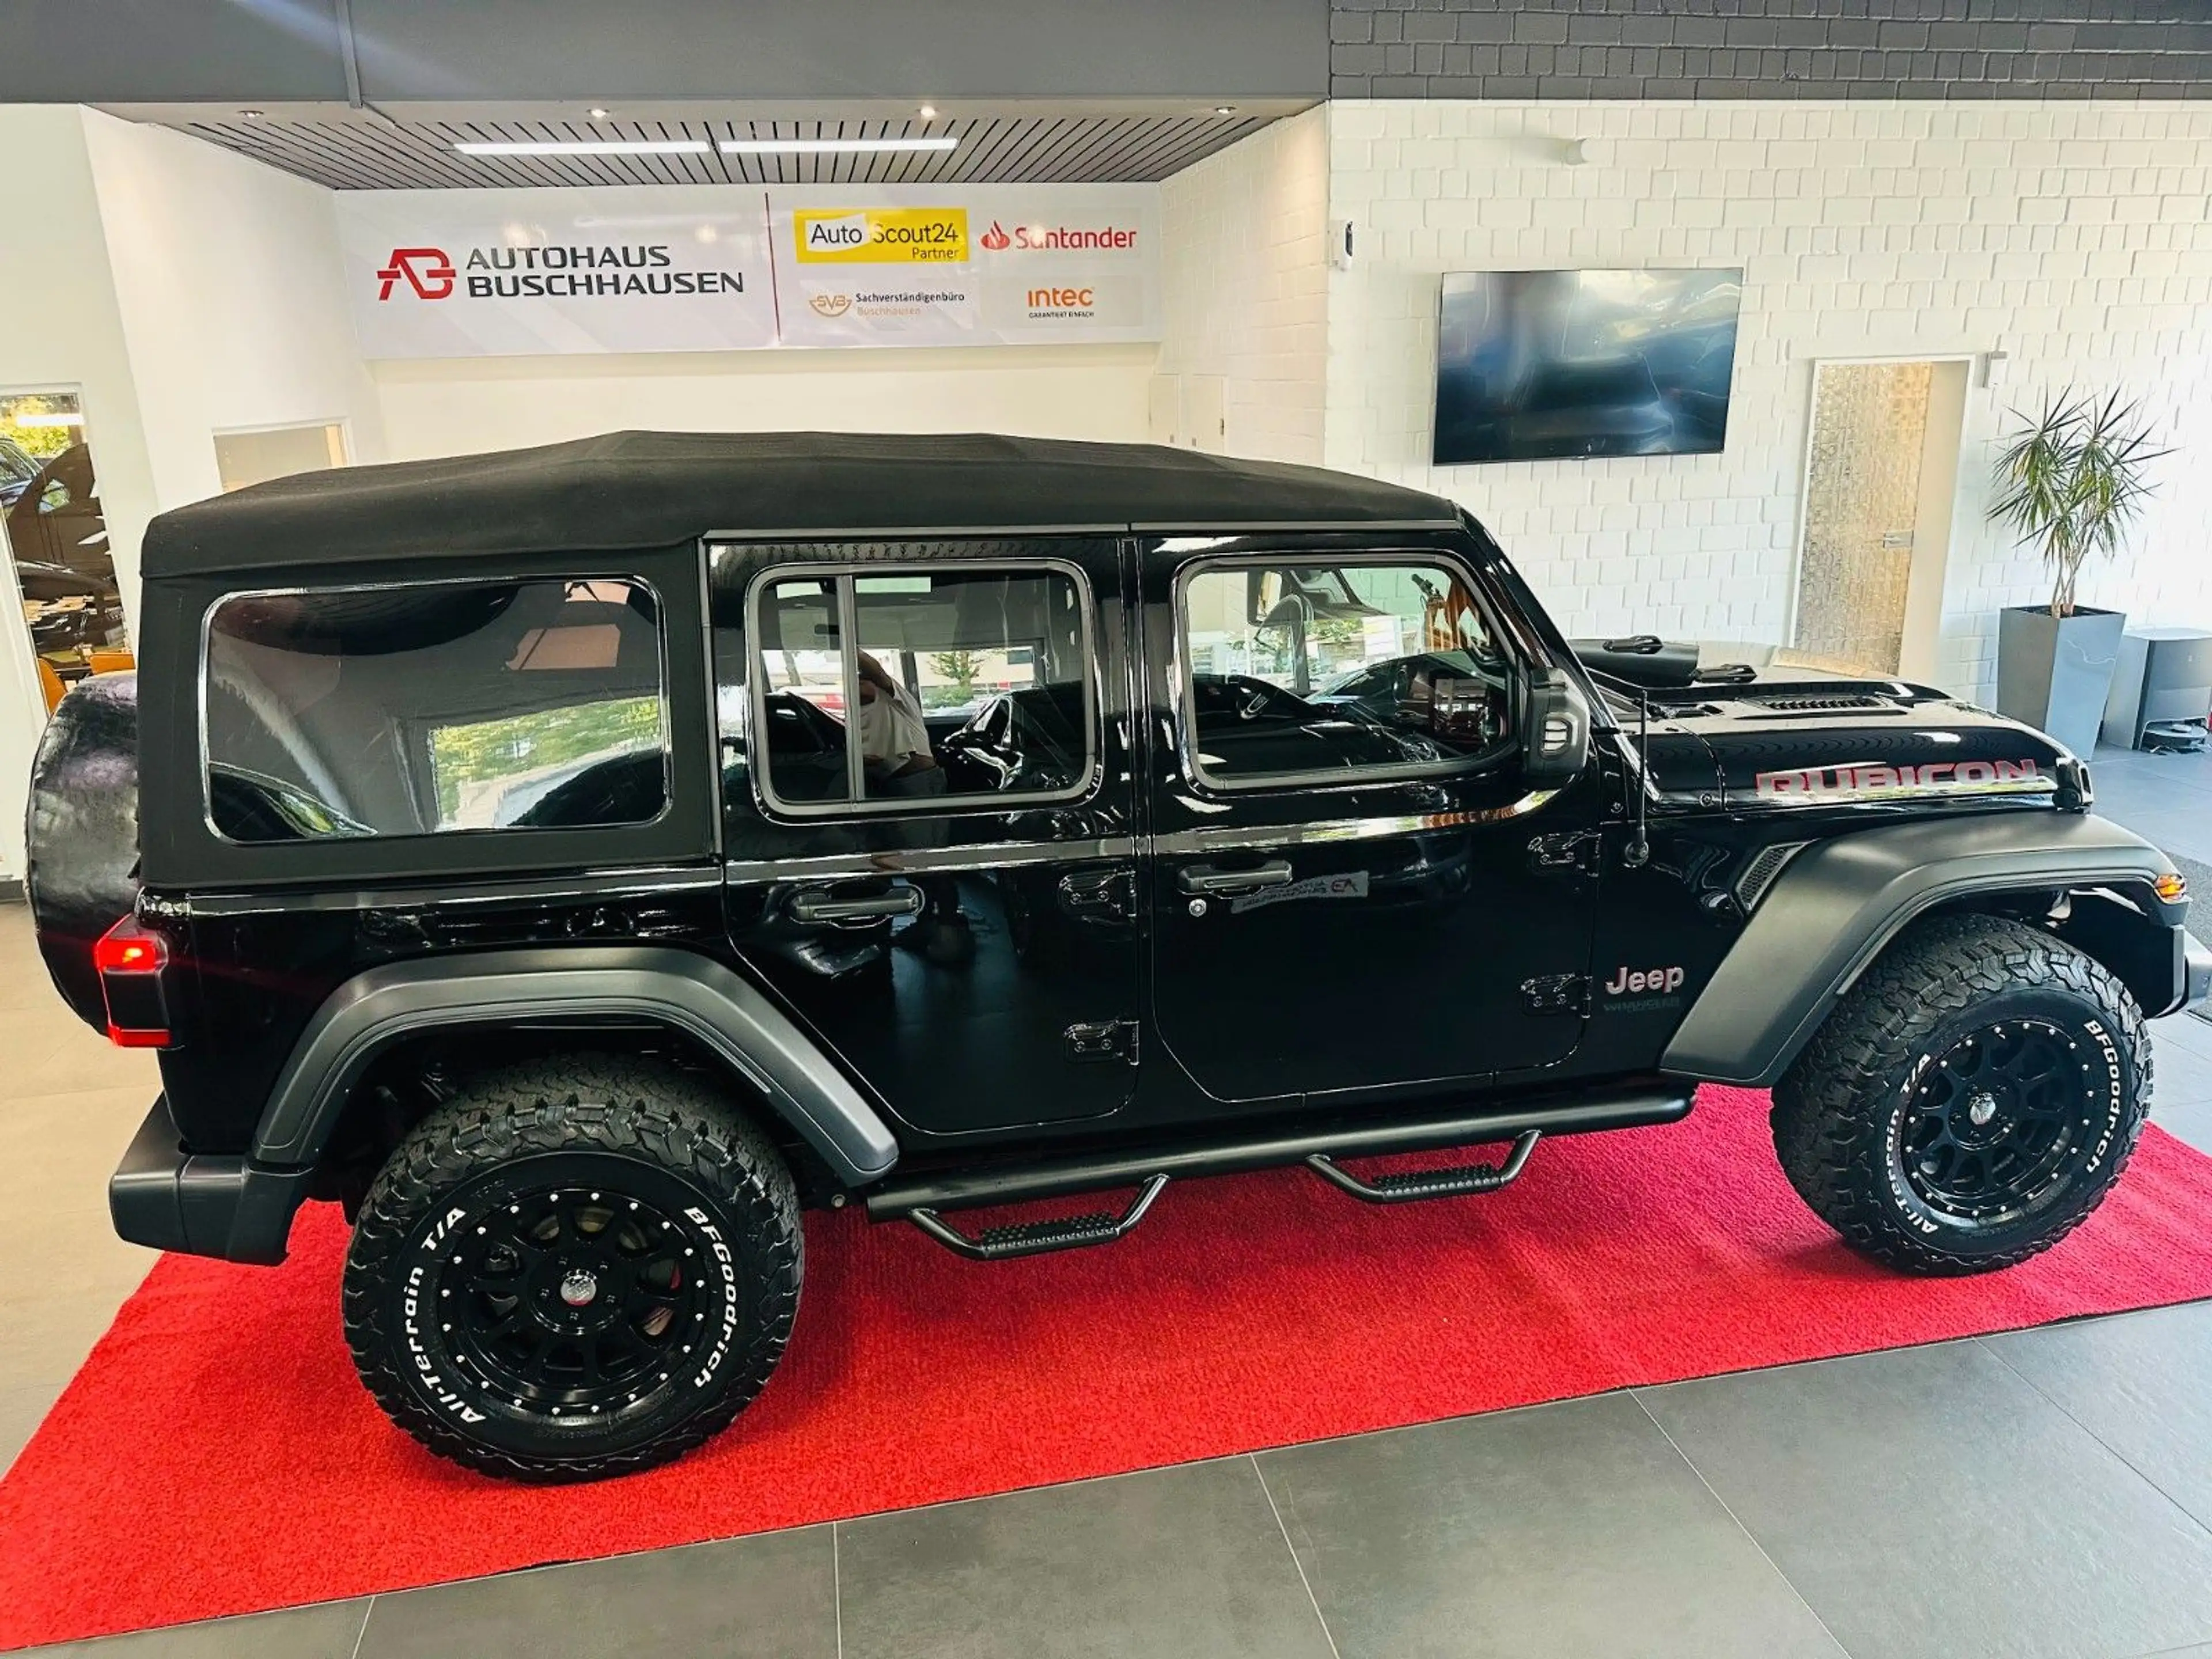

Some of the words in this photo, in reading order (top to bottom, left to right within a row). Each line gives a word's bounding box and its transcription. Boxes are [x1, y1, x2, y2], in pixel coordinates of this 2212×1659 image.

[810, 224, 862, 244] Auto
[467, 246, 671, 270] AUTOHAUS
[912, 247, 959, 259] Partner
[467, 272, 743, 297] BUSCHHAUSEN
[1028, 287, 1093, 307] intec
[855, 291, 965, 304] Sachverständigenbüro
[857, 306, 921, 316] Buschhausen
[1755, 759, 2037, 797] RUBICON
[1605, 966, 1684, 995] Jeep
[2083, 1020, 2120, 1173] BFGoodrich
[421, 1207, 467, 1251] T/A
[684, 1207, 737, 1387] BFGoodrich
[404, 1267, 487, 1423] All-Terrain
